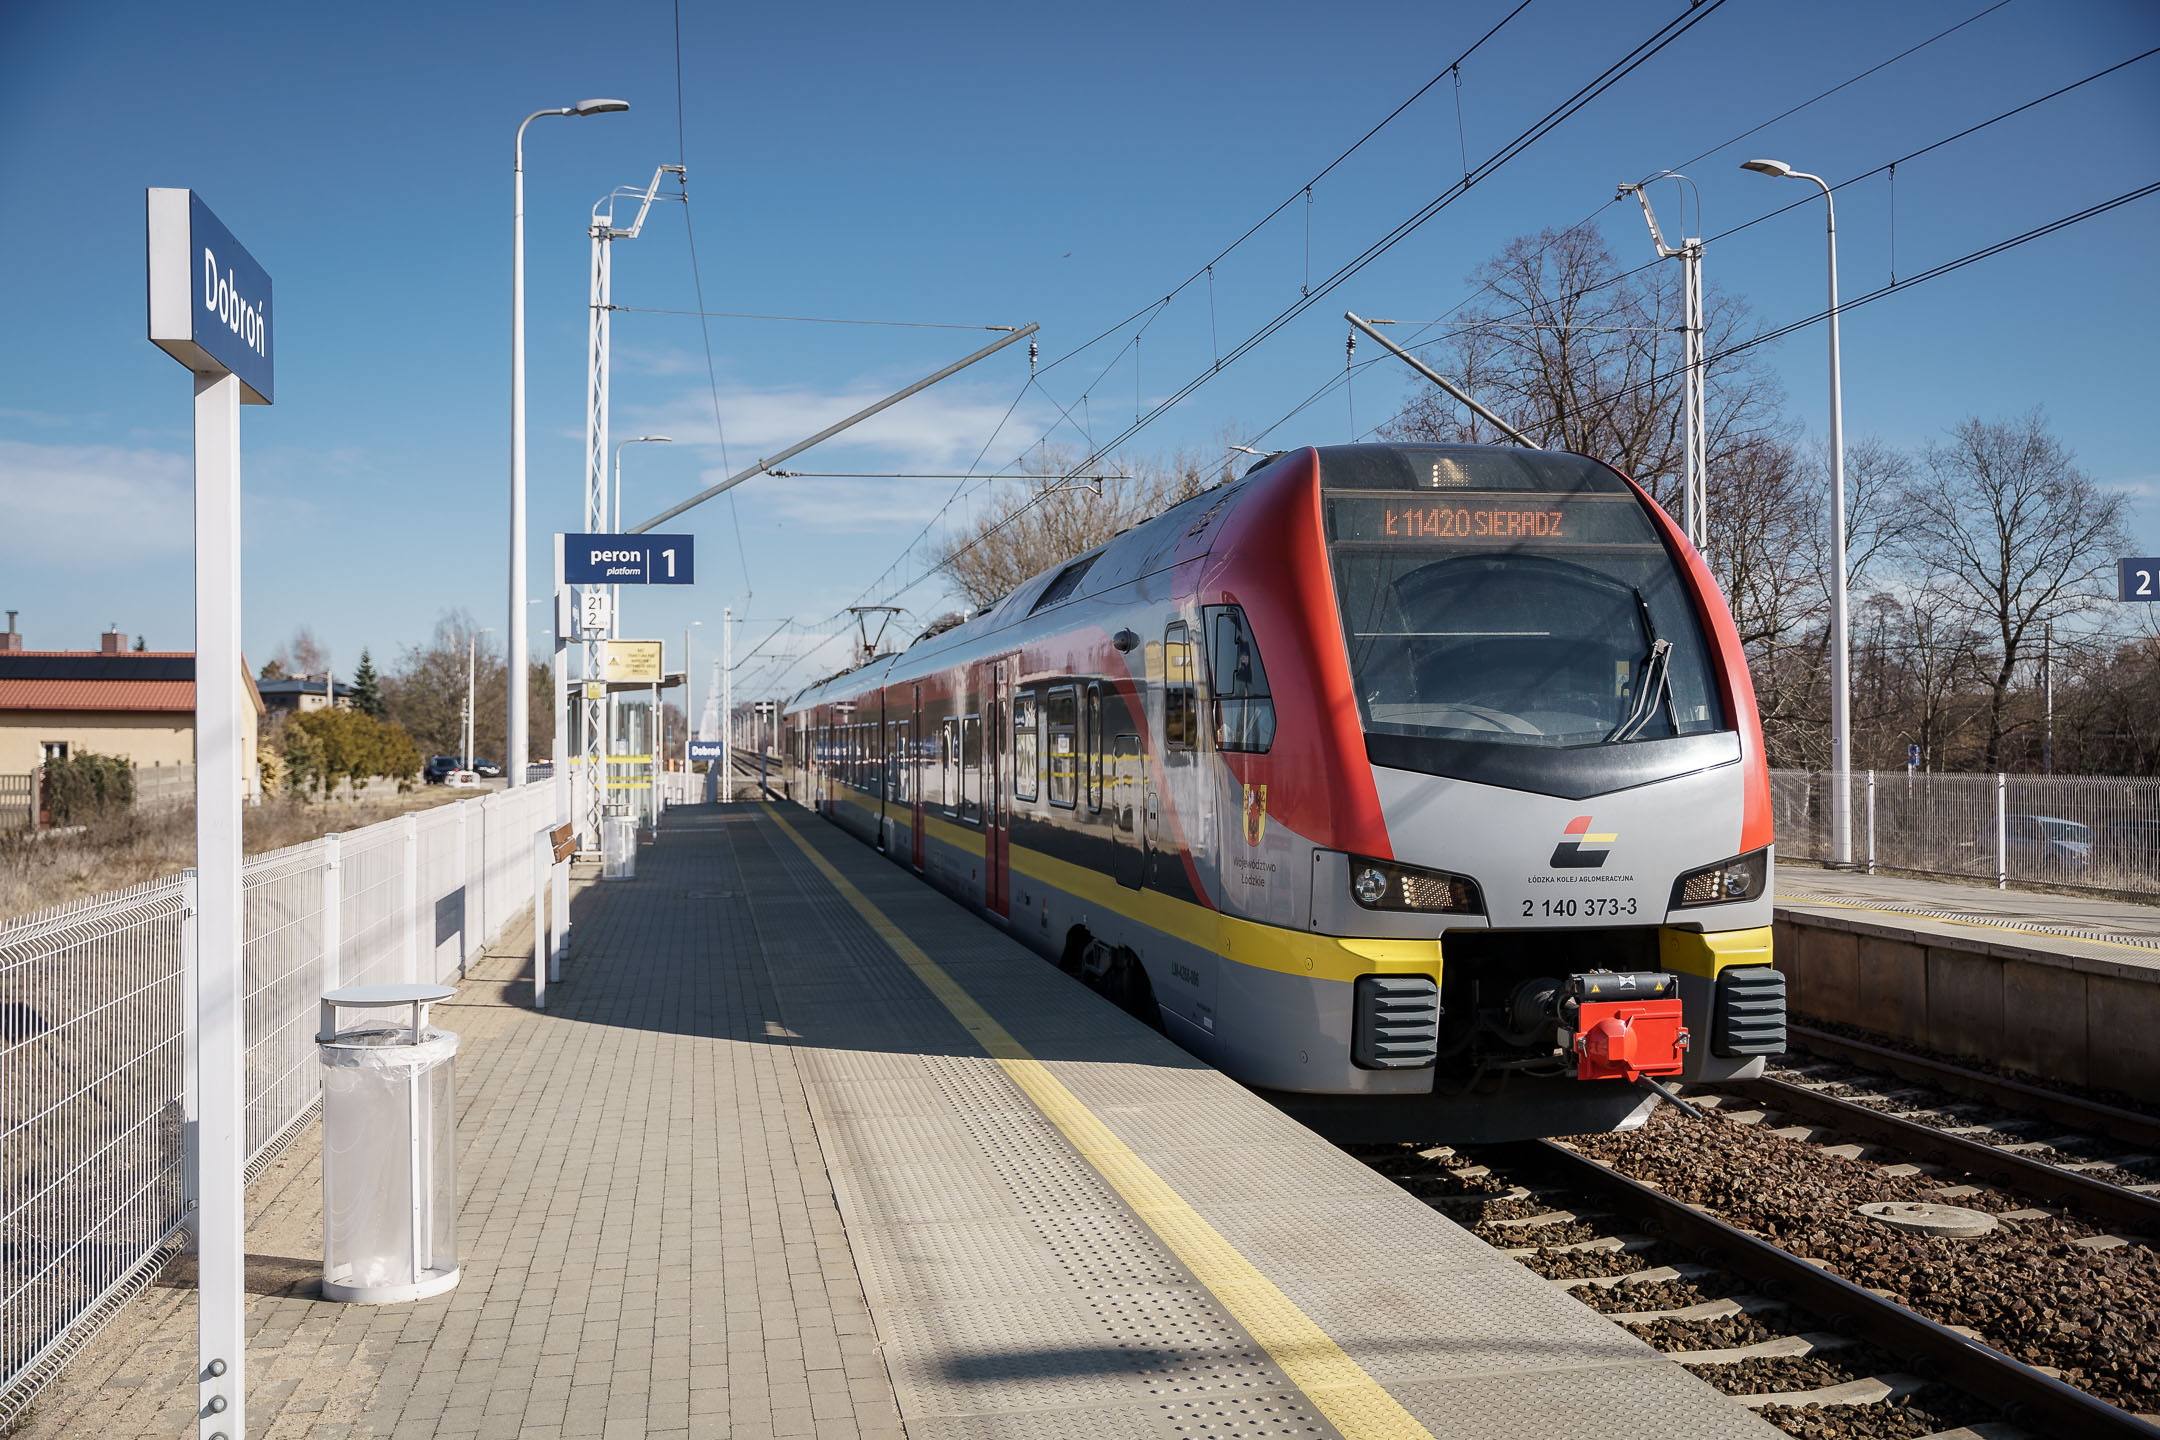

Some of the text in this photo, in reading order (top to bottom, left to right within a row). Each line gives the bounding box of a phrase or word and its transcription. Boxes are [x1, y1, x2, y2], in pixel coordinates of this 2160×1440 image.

[205, 247, 265, 358] Dobroń
[1386, 508, 1563, 537] Ł 11420 SIERADZ
[590, 549, 676, 578] peron 1
[606, 567, 641, 577] platform
[2135, 570, 2152, 595] 2
[588, 596, 603, 610] 21
[588, 612, 597, 626] 2
[1579, 875, 1634, 883] AGLOMERACYJNA
[1522, 897, 1638, 917] 2 140 373-3
